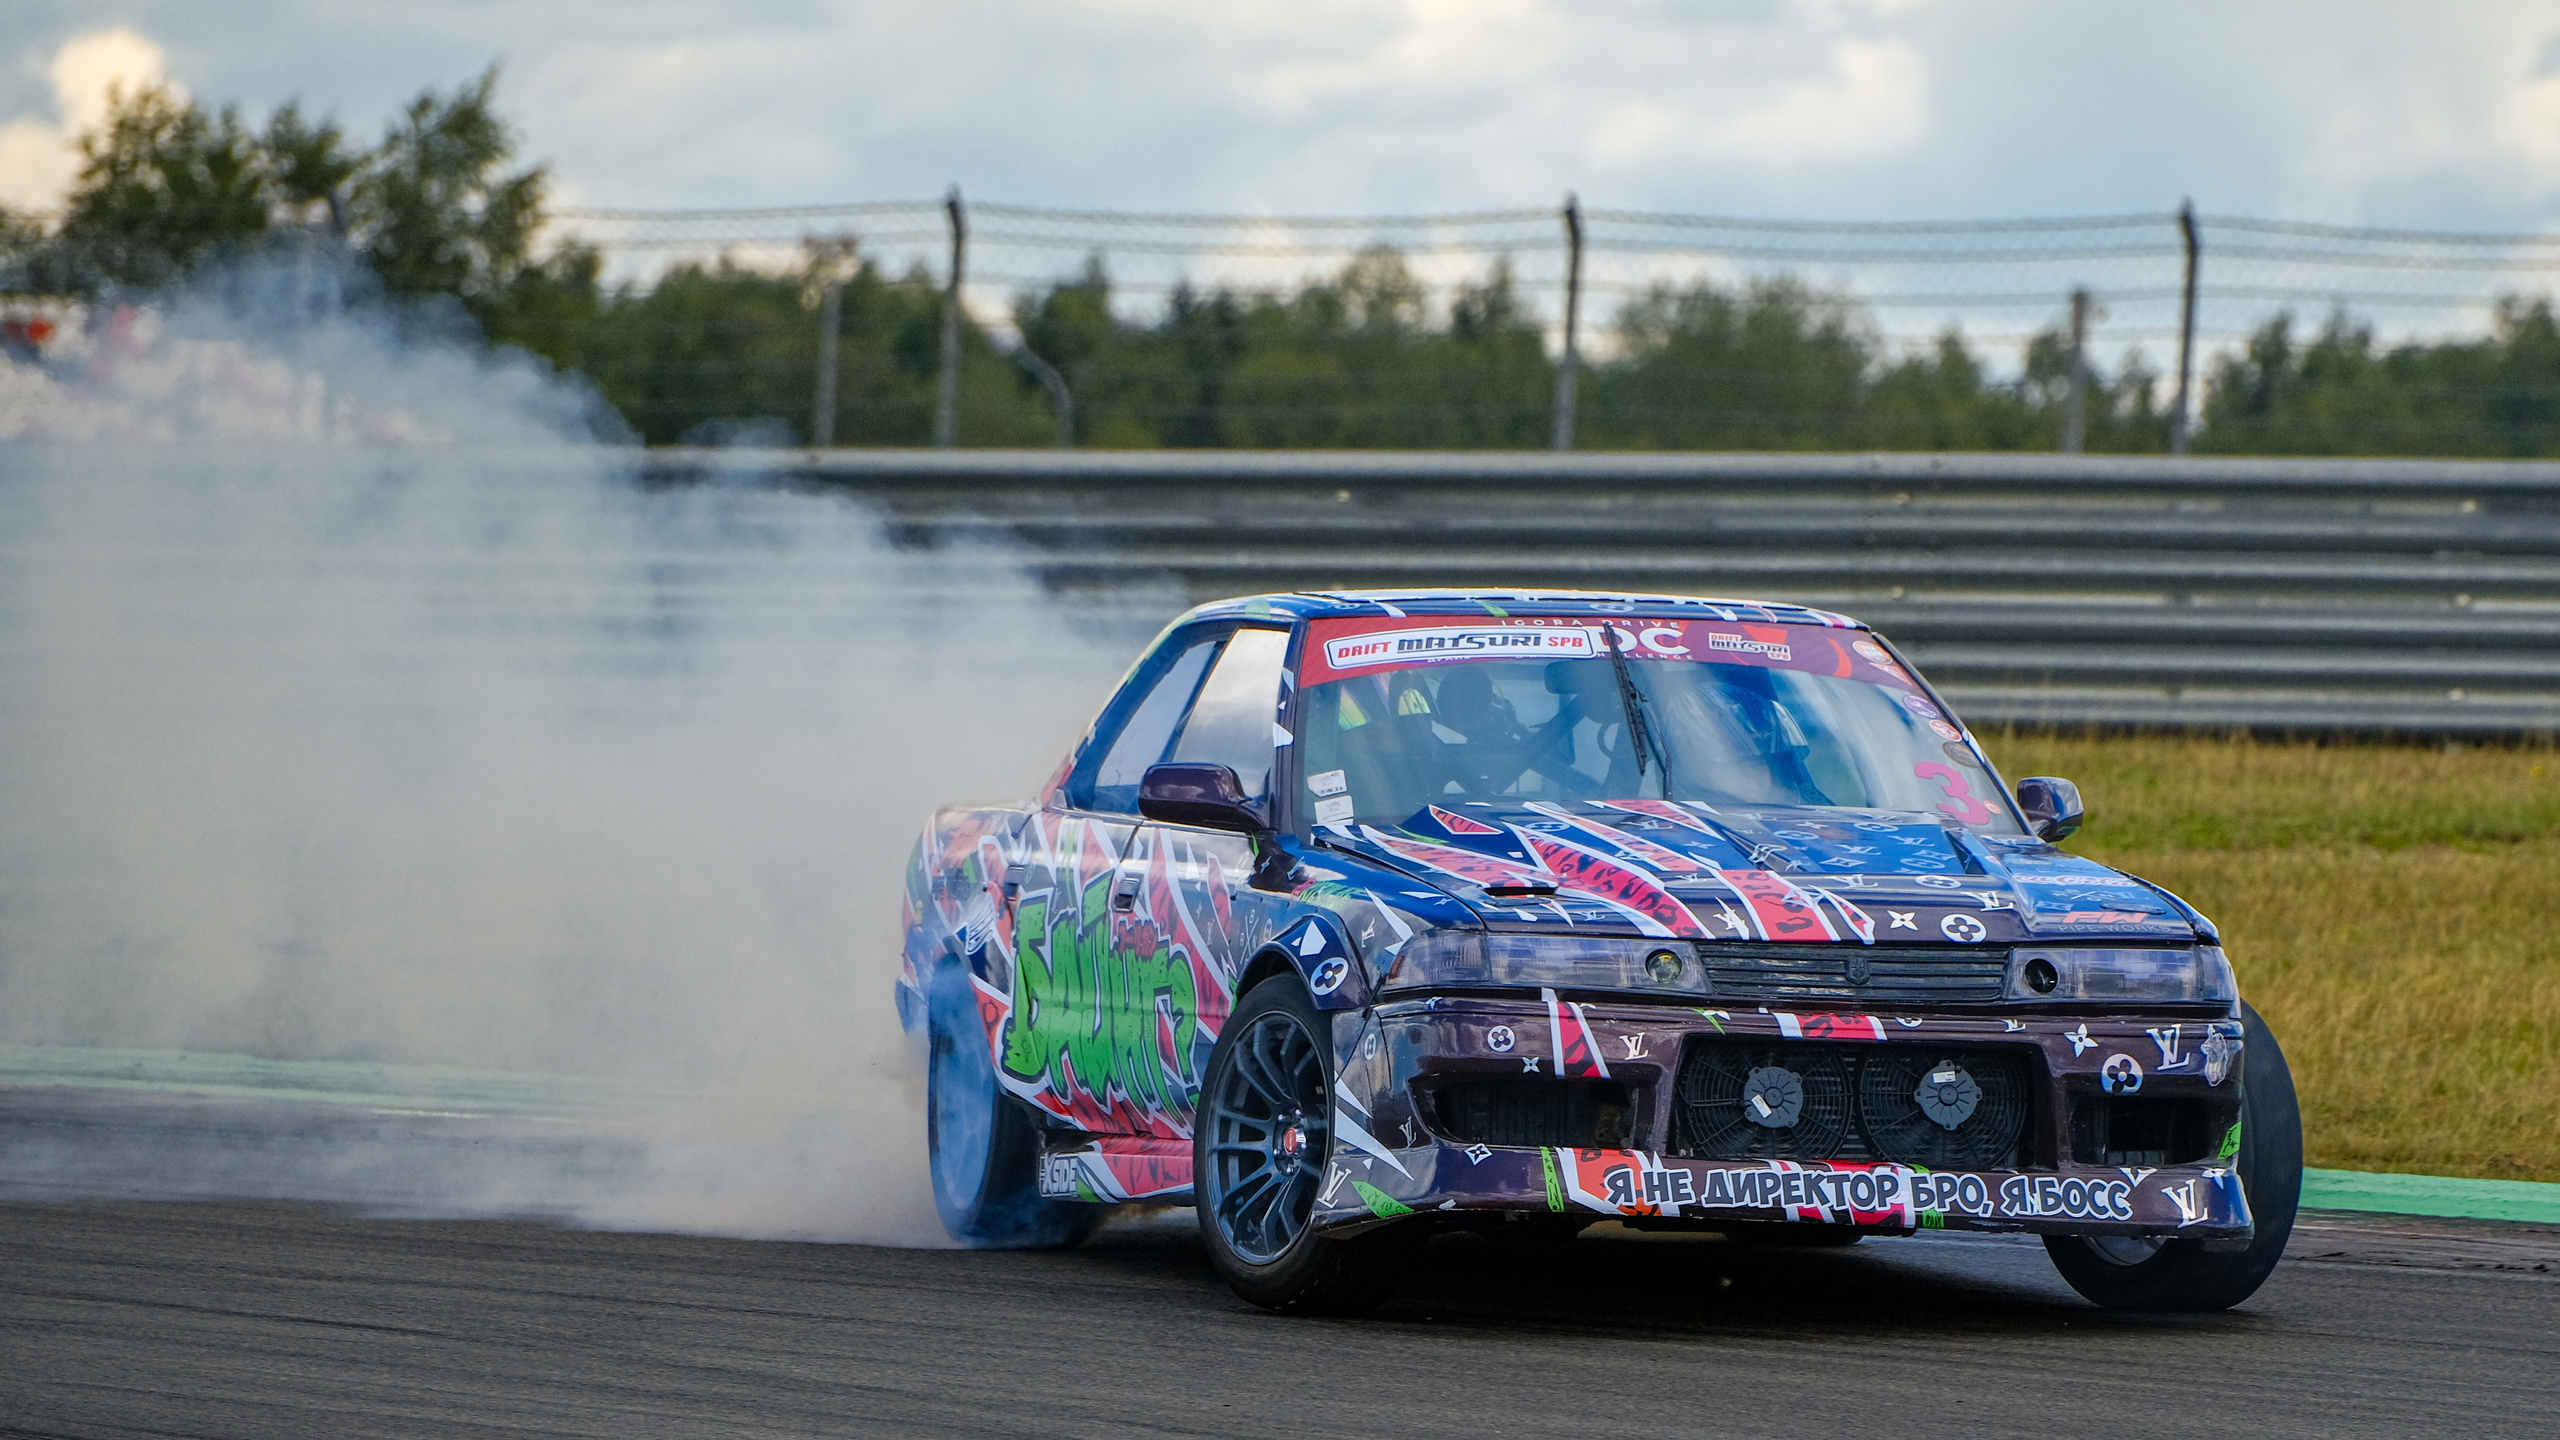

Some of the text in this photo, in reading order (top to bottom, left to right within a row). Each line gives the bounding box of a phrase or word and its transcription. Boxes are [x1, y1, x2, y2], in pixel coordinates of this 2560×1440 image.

[1602, 619, 1680, 629] DRIVE
[1338, 633, 1584, 659] DRIFT MATSURI SPB
[1711, 640, 1789, 654] MATSURI
[1914, 761, 1990, 825] 3
[2058, 924, 2100, 932] PIPE
[1604, 1169, 1634, 1206] Я
[1643, 1169, 1695, 1206] НЕ
[1702, 1170, 1899, 1211] ДИРЕКТОР
[1910, 1172, 1994, 1217] БРО,
[2000, 1175, 2029, 1217] Я
[2035, 1177, 2133, 1220] БОСС
